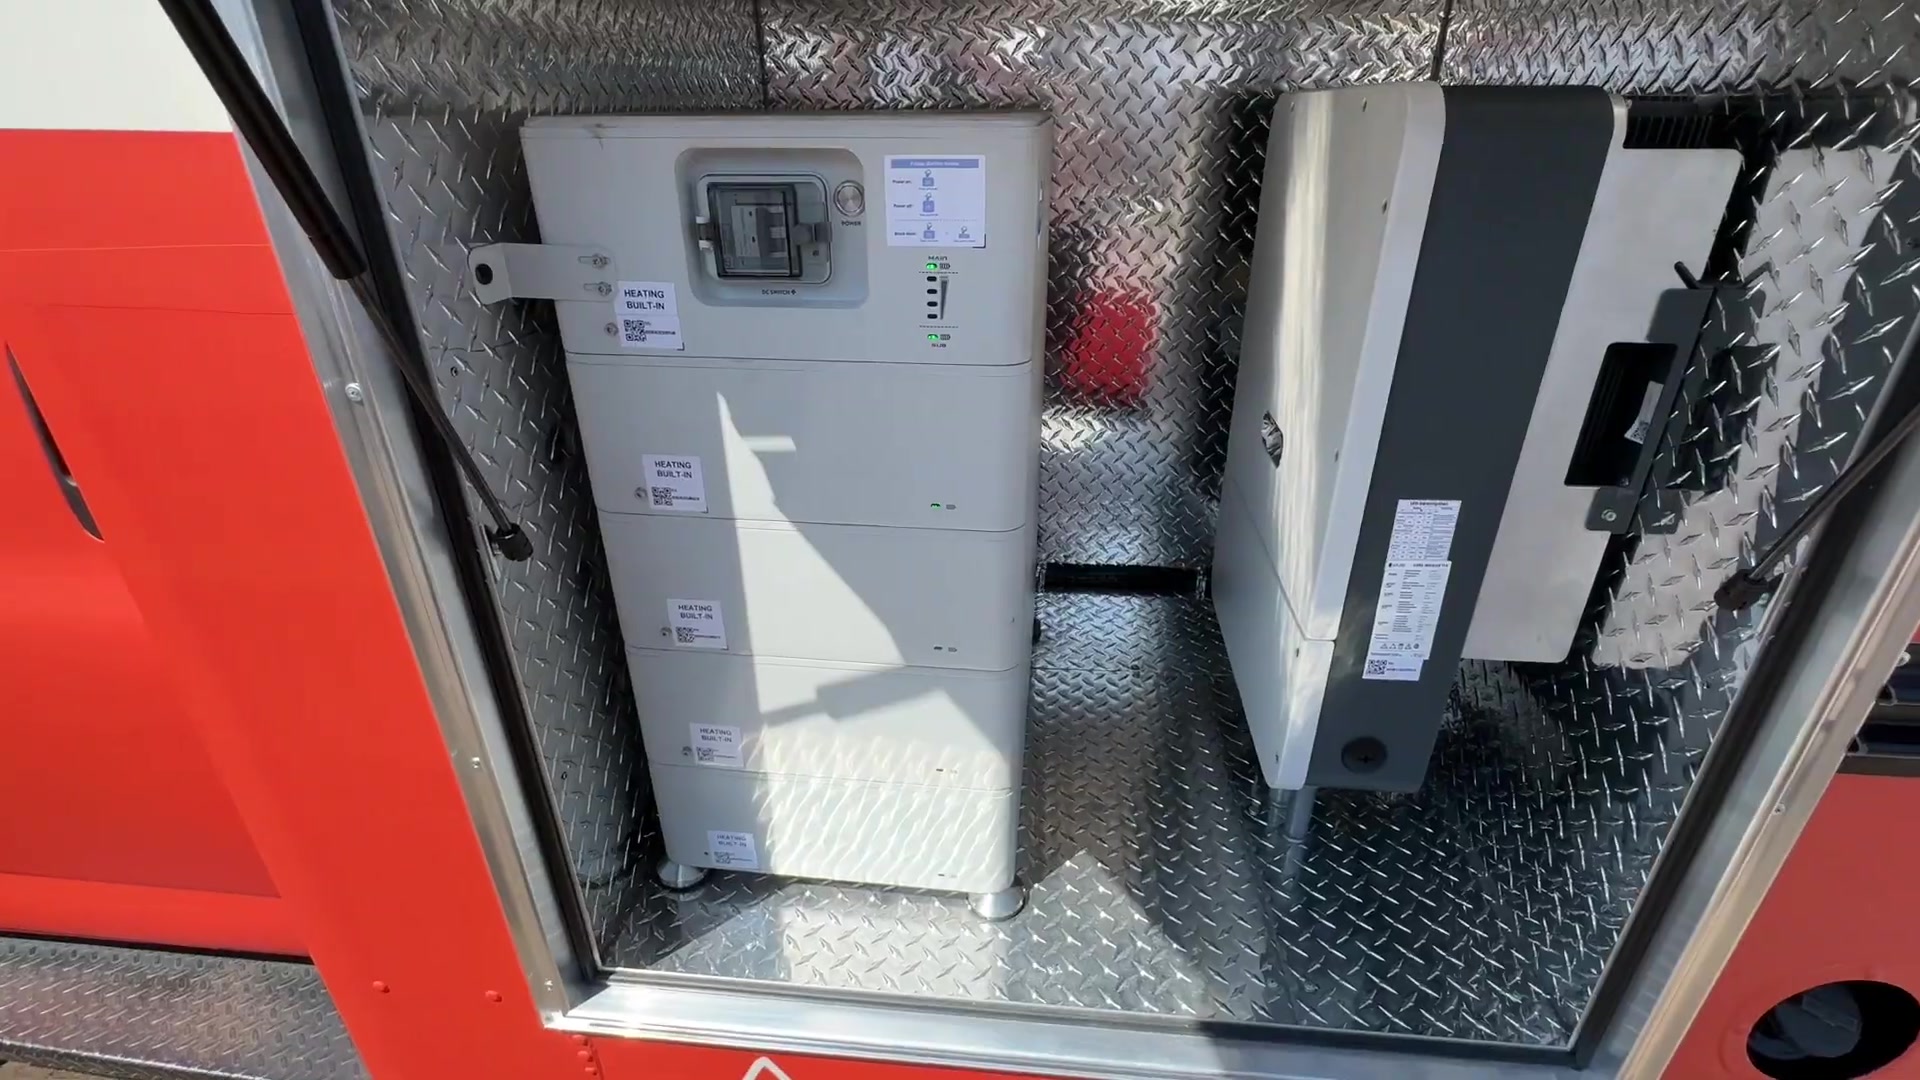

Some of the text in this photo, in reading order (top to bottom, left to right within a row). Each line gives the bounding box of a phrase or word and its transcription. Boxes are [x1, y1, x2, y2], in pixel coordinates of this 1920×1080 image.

[624, 289, 665, 299] HEATING
[626, 301, 665, 310] BUILT-IN
[654, 460, 692, 469] HEATING
[657, 470, 692, 478] BUILT-IN
[678, 604, 713, 612] HEATING
[680, 612, 713, 620] BUILT-IN
[700, 728, 732, 736] HEATING
